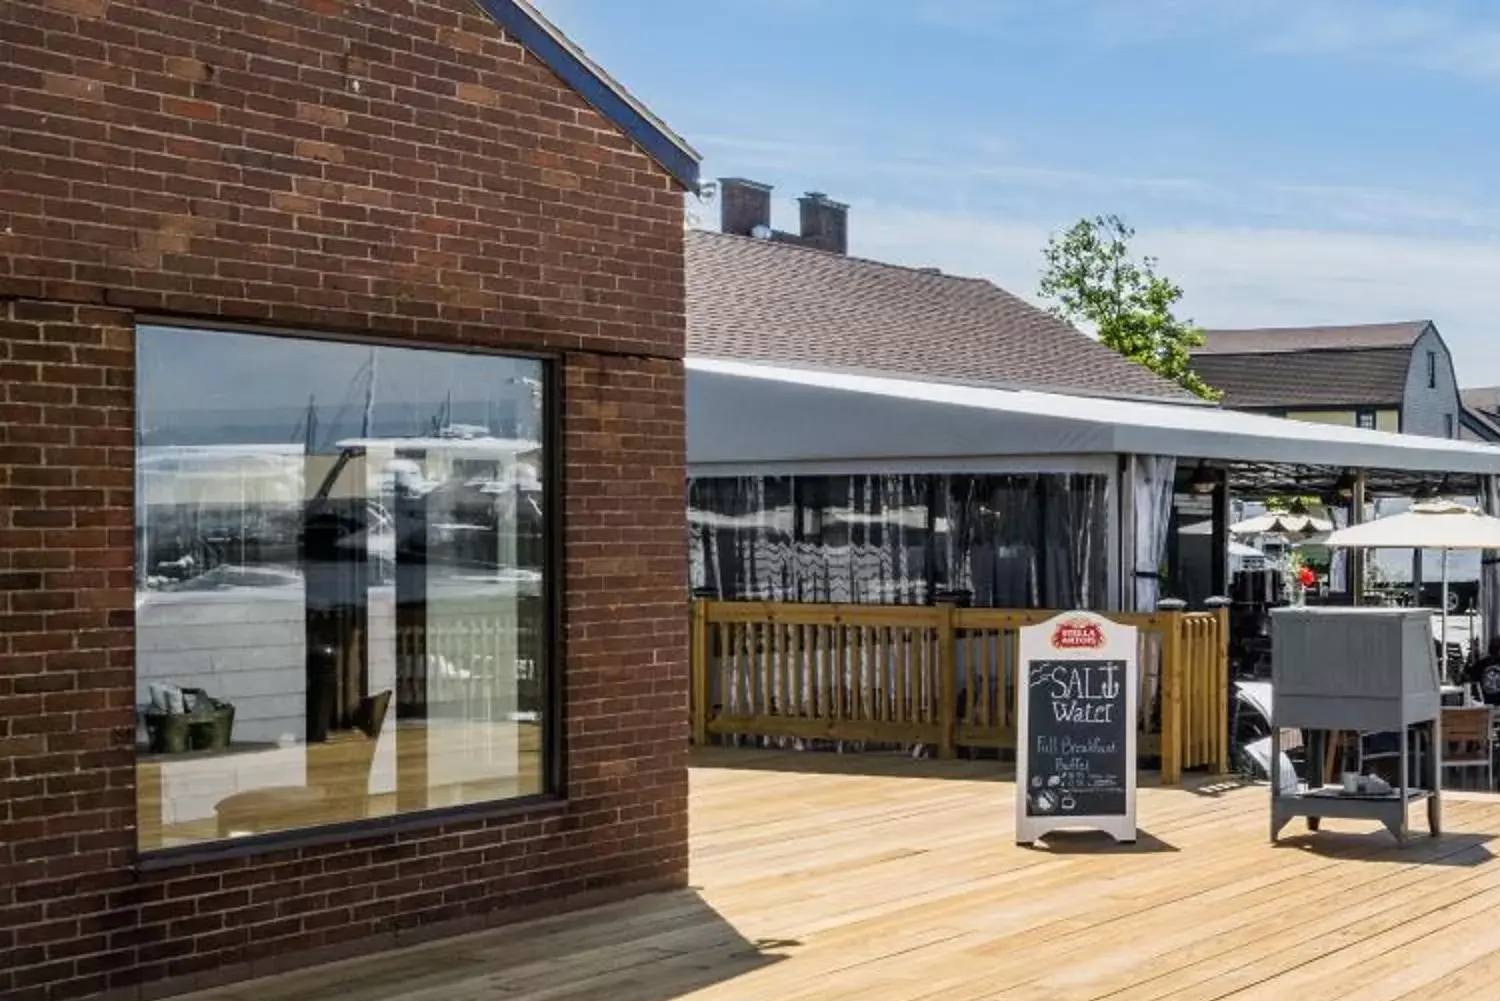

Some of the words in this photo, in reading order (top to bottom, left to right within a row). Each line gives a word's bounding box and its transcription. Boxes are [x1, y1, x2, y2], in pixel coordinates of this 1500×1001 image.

[1050, 663, 1119, 699] SALT
[1052, 700, 1114, 723] Water
[1037, 735, 1057, 753] Full
